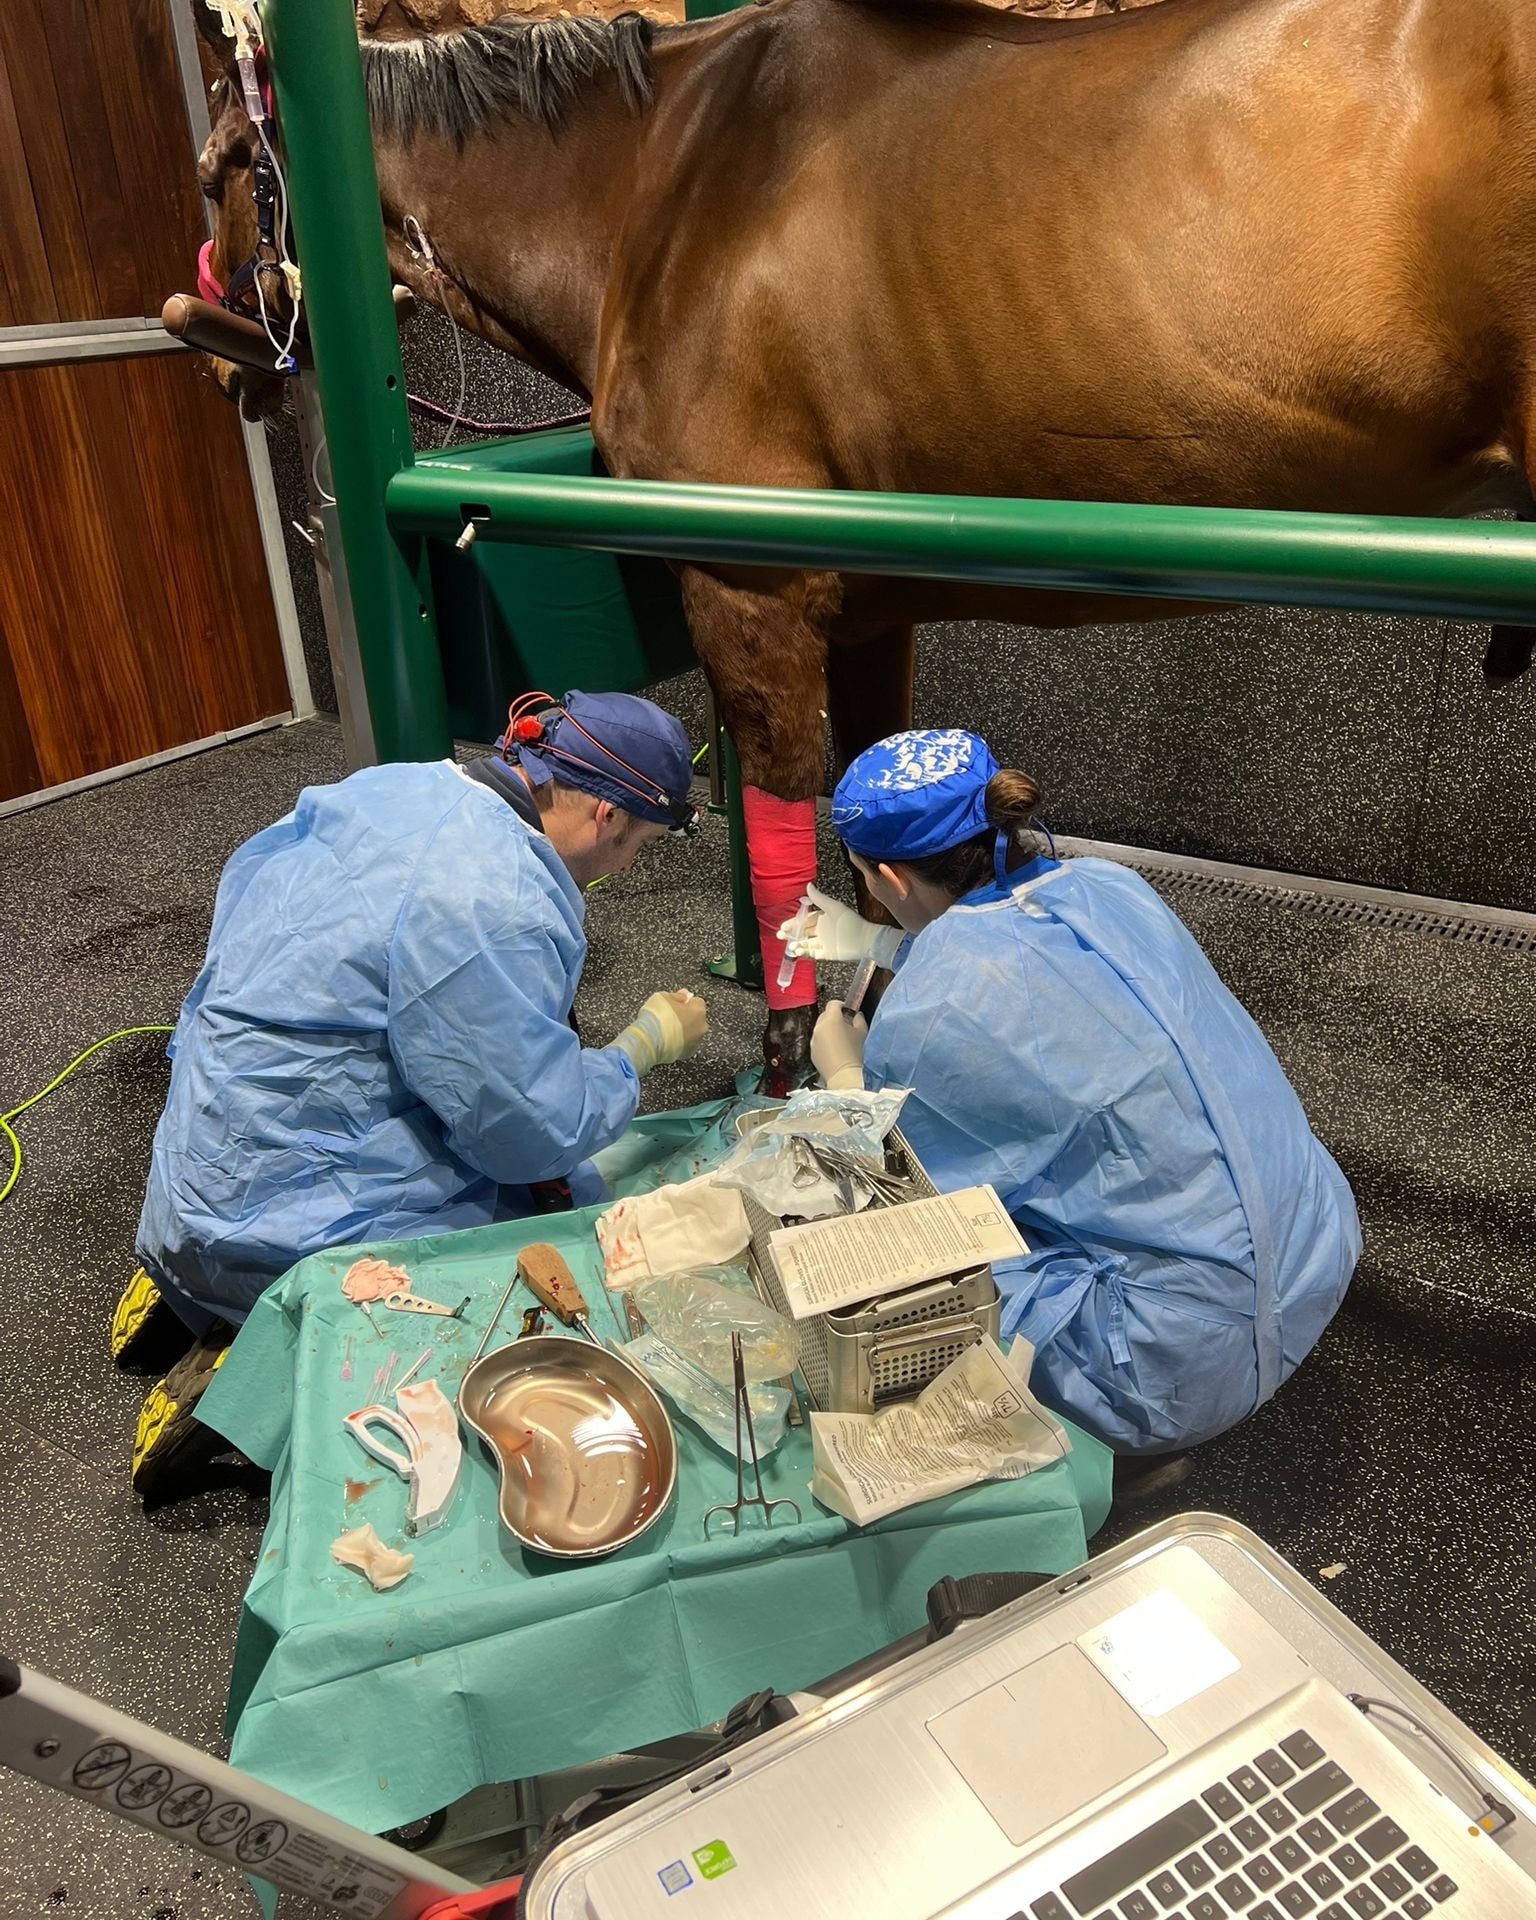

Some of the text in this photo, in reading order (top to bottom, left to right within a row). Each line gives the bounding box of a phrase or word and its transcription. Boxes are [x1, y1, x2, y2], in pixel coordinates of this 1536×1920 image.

[1272, 1807, 1284, 1819] Z
[1244, 1826, 1257, 1838] X
[1310, 1827, 1322, 1839] A
[1218, 1844, 1229, 1856] C
[1285, 1846, 1297, 1858] S
[1343, 1854, 1356, 1866] Q
[1191, 1863, 1202, 1875] V
[1258, 1864, 1270, 1877] D
[1317, 1872, 1331, 1886] W
[1162, 1882, 1174, 1894] B
[1231, 1884, 1243, 1897] F
[1291, 1891, 1303, 1905] E
[1355, 1889, 1365, 1900] 2
[1132, 1902, 1145, 1914] N
[1202, 1904, 1213, 1916] G
